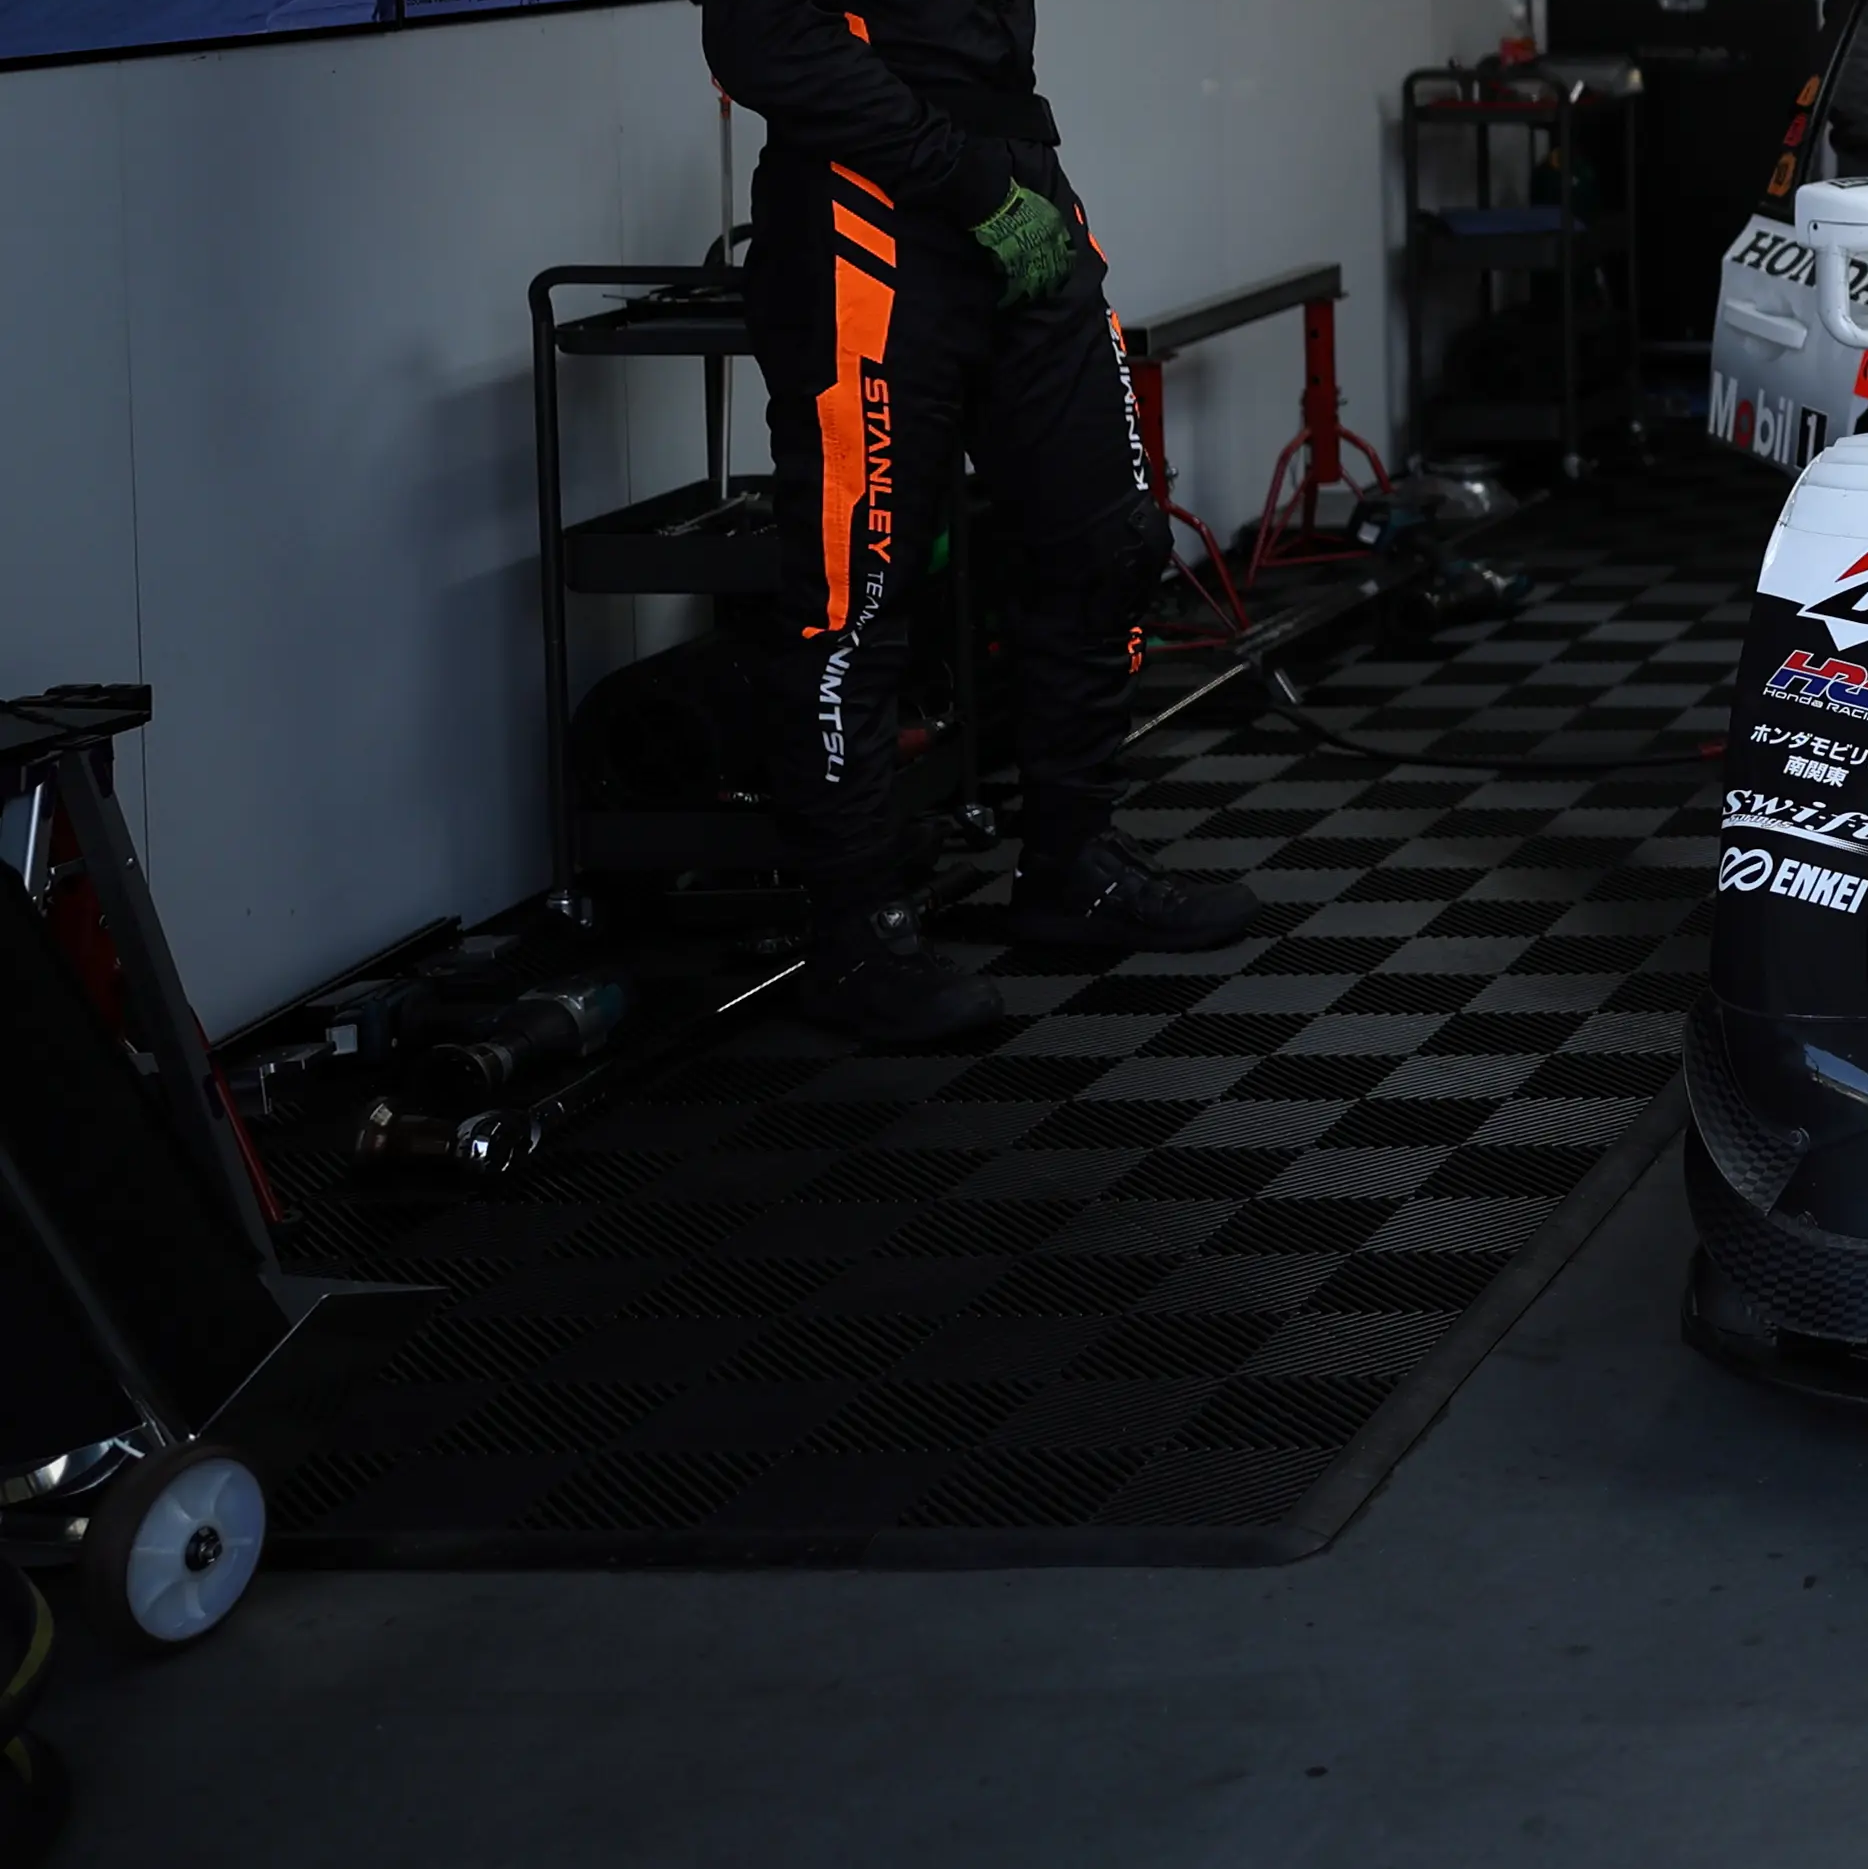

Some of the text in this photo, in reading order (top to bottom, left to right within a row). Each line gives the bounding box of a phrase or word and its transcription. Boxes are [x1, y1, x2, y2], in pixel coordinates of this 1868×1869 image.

[1708, 369, 1794, 465] Mobil
[864, 376, 893, 565] STANLEY
[1762, 686, 1824, 709] Honda
[1782, 754, 1850, 789] 南関東
